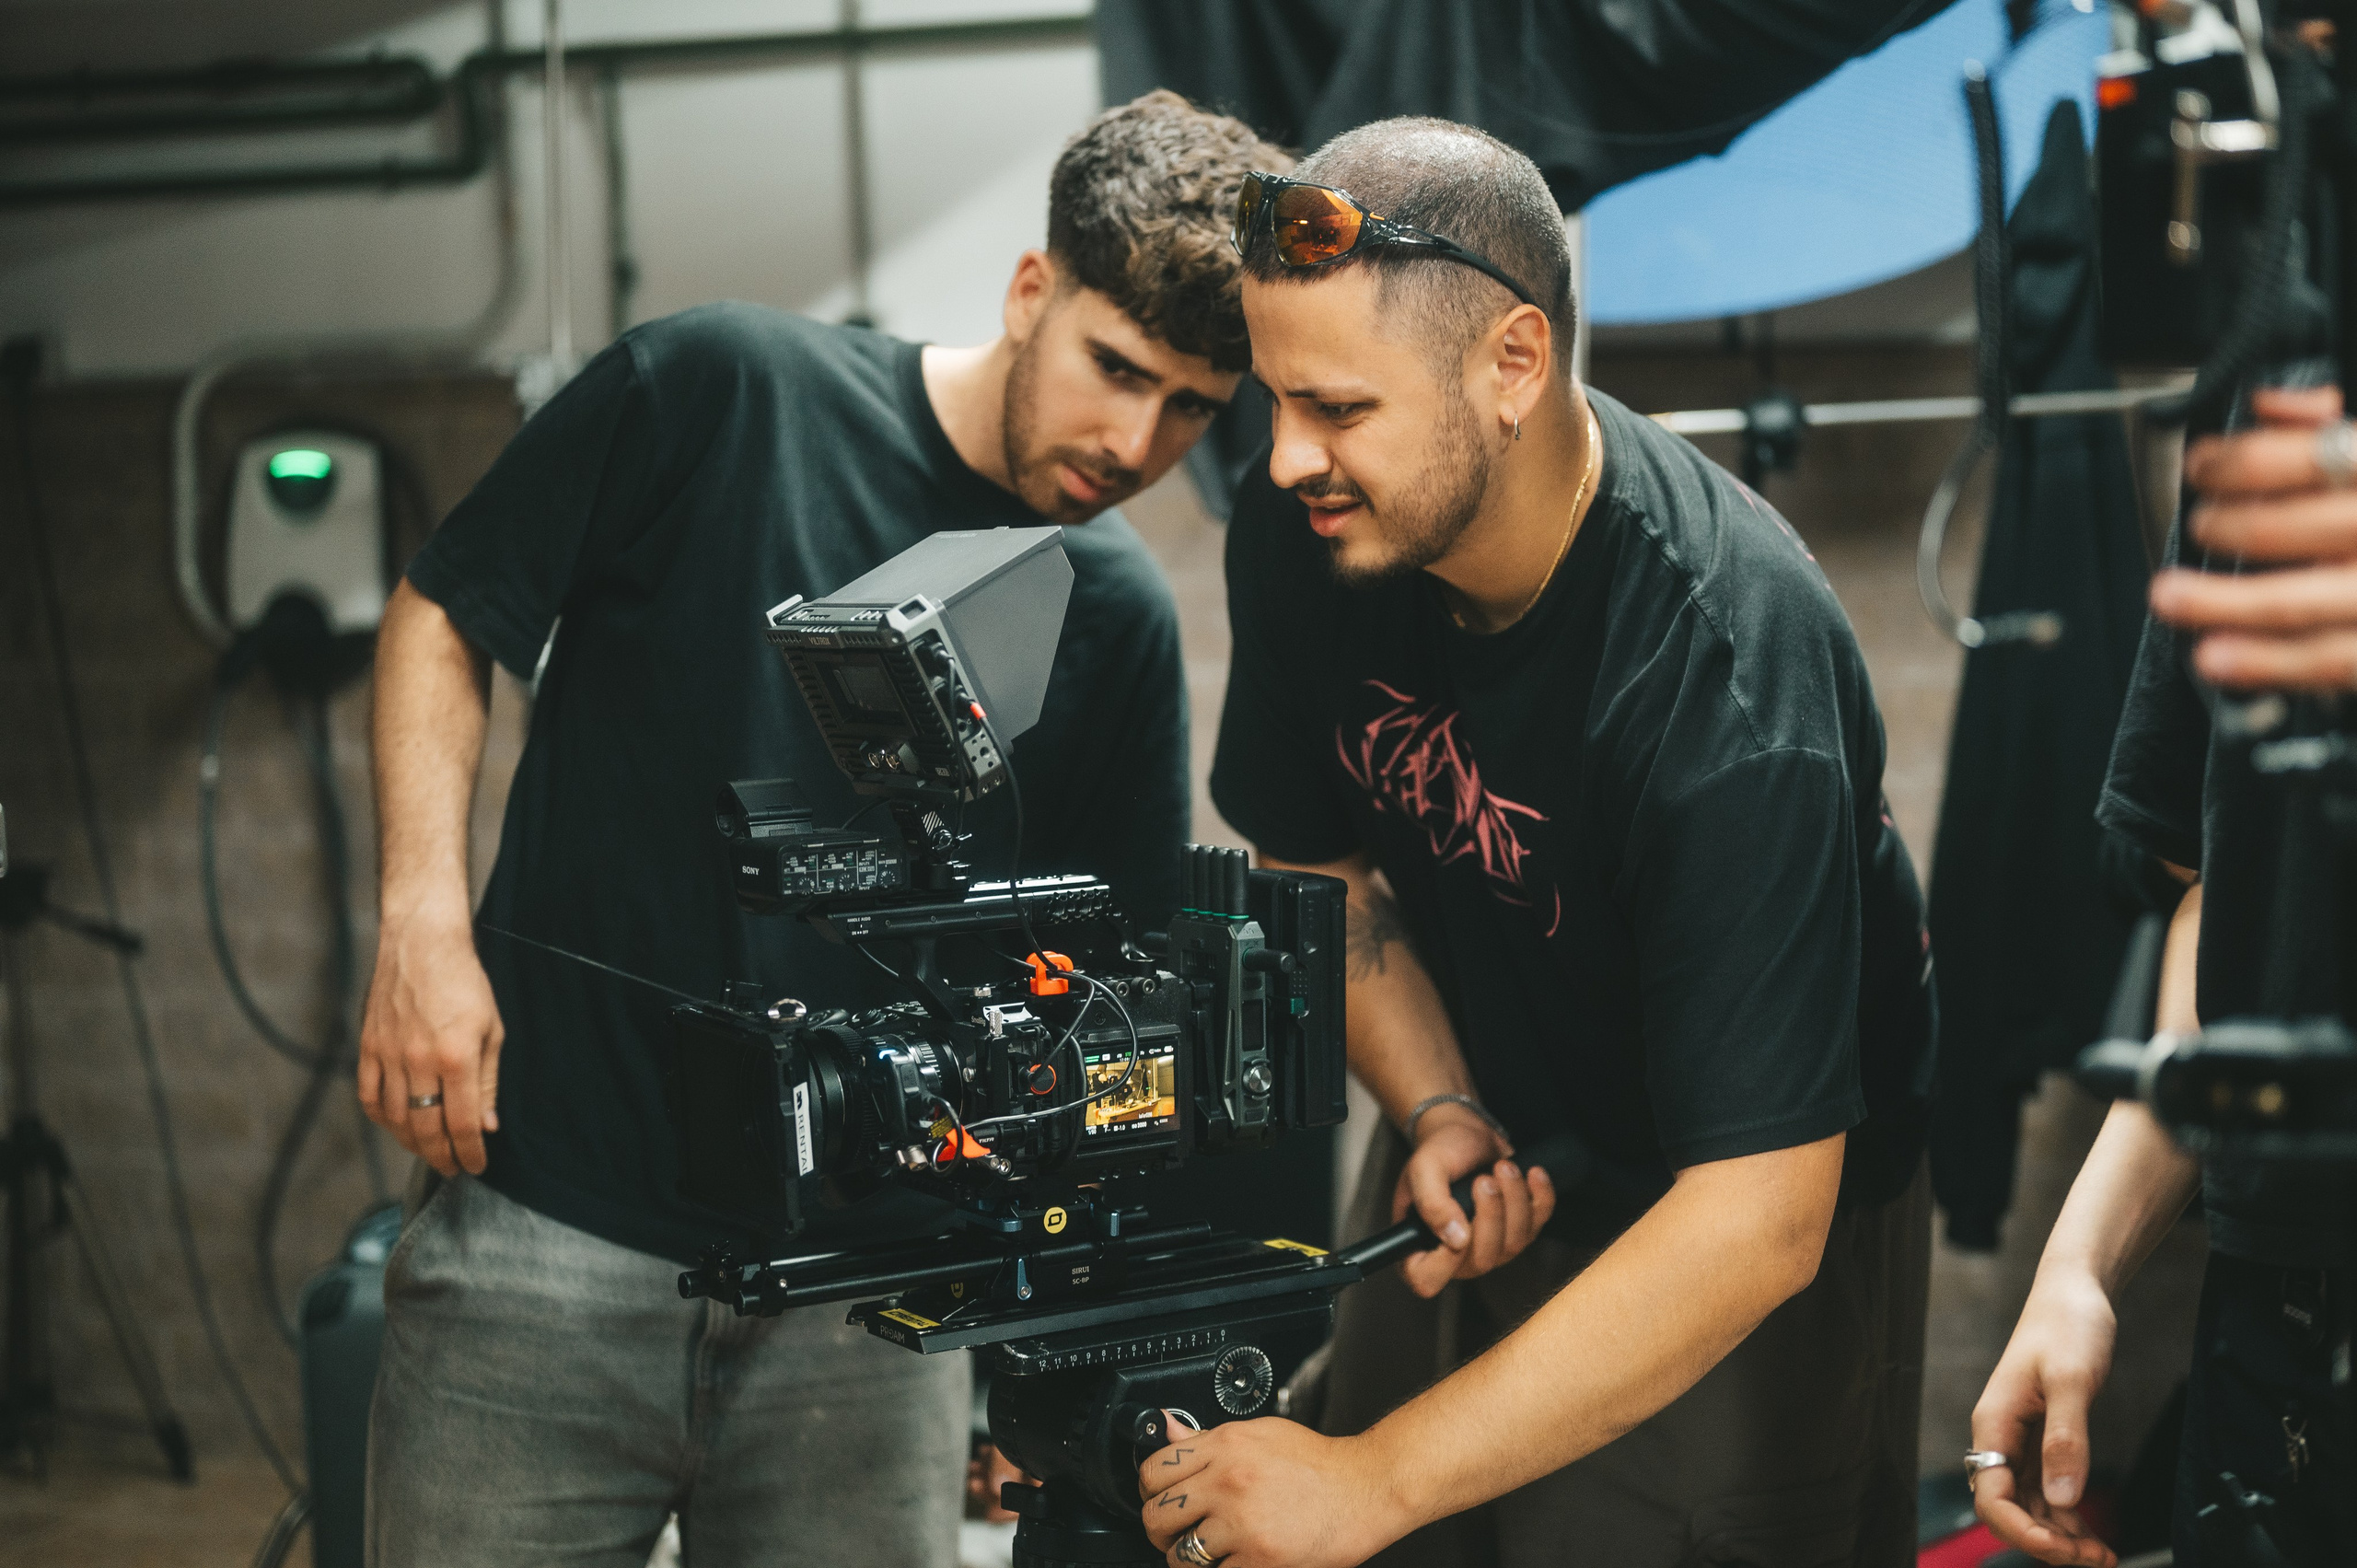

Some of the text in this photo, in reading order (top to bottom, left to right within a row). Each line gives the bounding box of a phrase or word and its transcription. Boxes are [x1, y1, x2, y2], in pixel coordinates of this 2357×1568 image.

[741, 865, 760, 876] SONY
[1072, 1266, 1090, 1275] SIRUI
[1039, 1359, 1047, 1367] 12
[1101, 1349, 1106, 1357] 8
